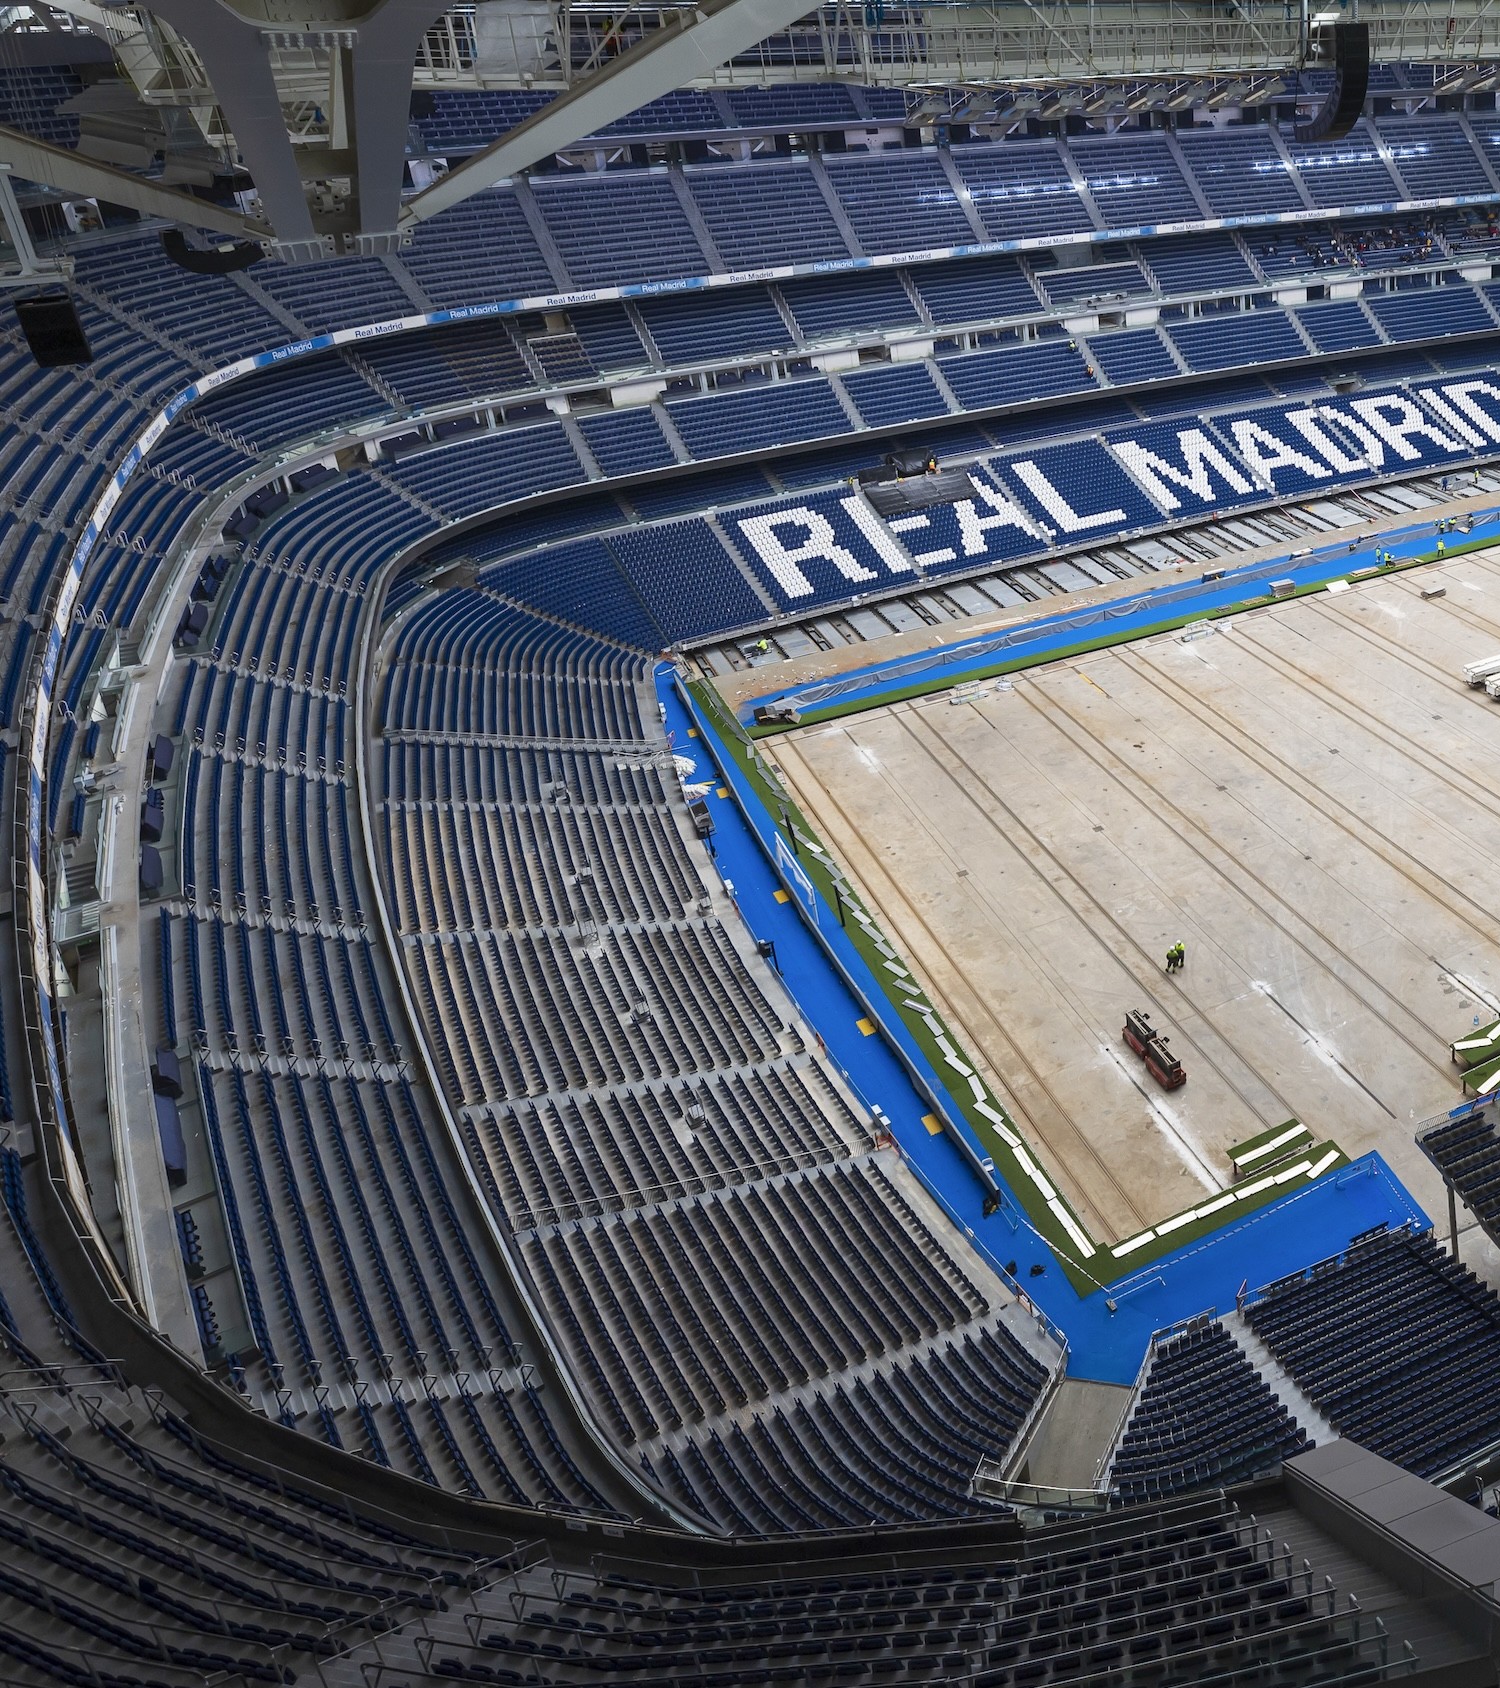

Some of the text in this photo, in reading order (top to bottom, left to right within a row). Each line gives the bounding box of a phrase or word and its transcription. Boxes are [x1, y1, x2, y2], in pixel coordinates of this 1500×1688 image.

[1308, 210, 1326, 218] Madrid
[1186, 222, 1205, 230] Madrid
[1120, 228, 1140, 236] Madrid
[1053, 236, 1074, 244] Madrid
[909, 252, 931, 261] Madrid
[814, 260, 853, 271] Real Madrid
[750, 271, 773, 280] Madrid
[642, 280, 686, 292] Real Madrid
[547, 292, 596, 305] Real Madrid
[450, 304, 498, 319] Real Madrid
[355, 322, 403, 338] Real Madrid
[272, 342, 313, 360] Real Madrid
[737, 460, 1127, 599] REAL
